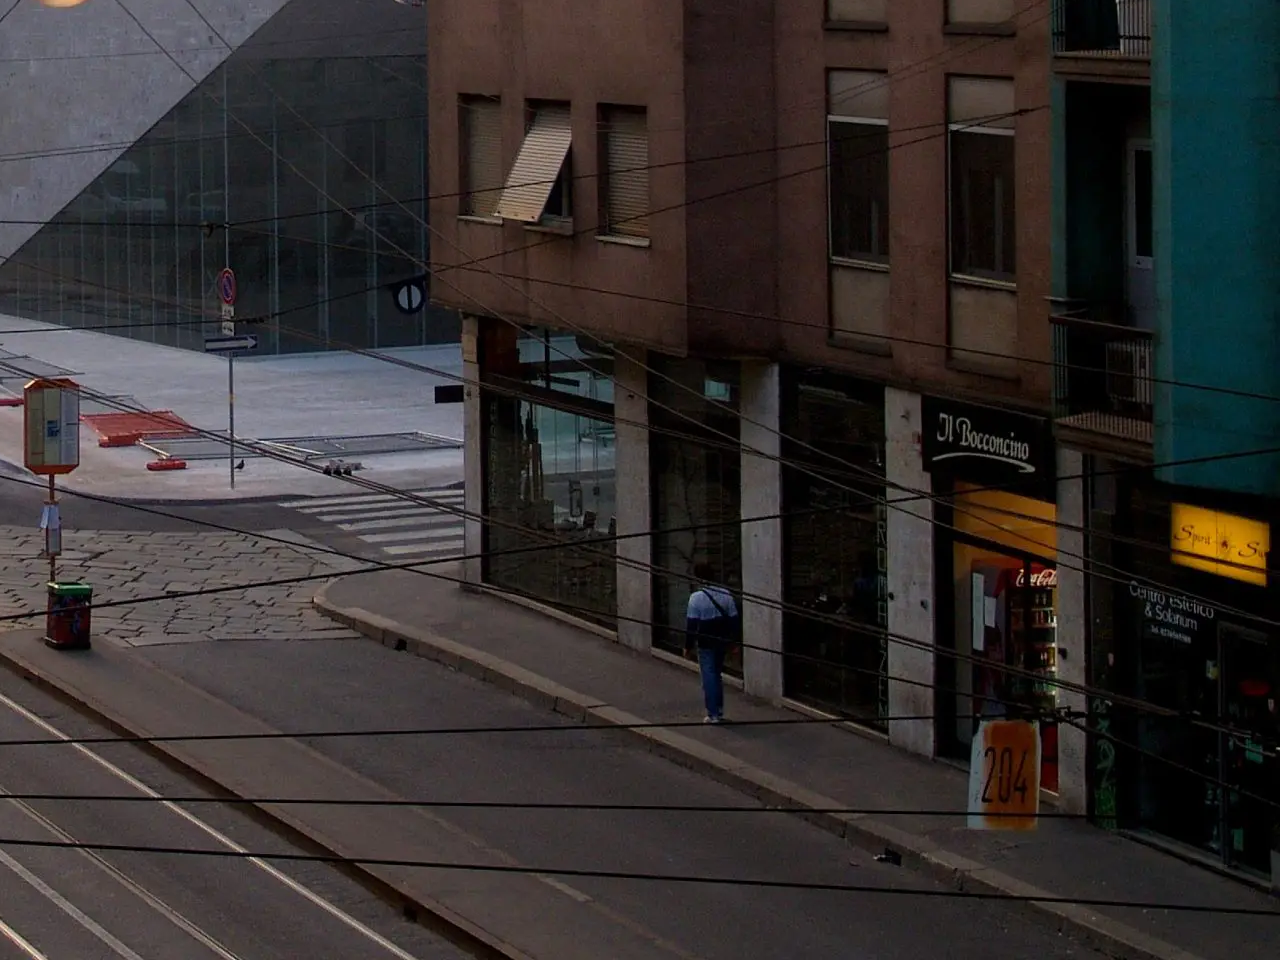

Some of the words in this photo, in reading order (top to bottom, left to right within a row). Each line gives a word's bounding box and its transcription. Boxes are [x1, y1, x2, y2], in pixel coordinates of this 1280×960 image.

[936, 412, 954, 443] Il
[956, 417, 1029, 460] Bocconcino
[1129, 581, 1166, 605] Centro
[1169, 594, 1215, 619] estetico
[1144, 602, 1153, 618] &
[1155, 604, 1198, 631] Solarium
[981, 746, 1028, 803] 204
